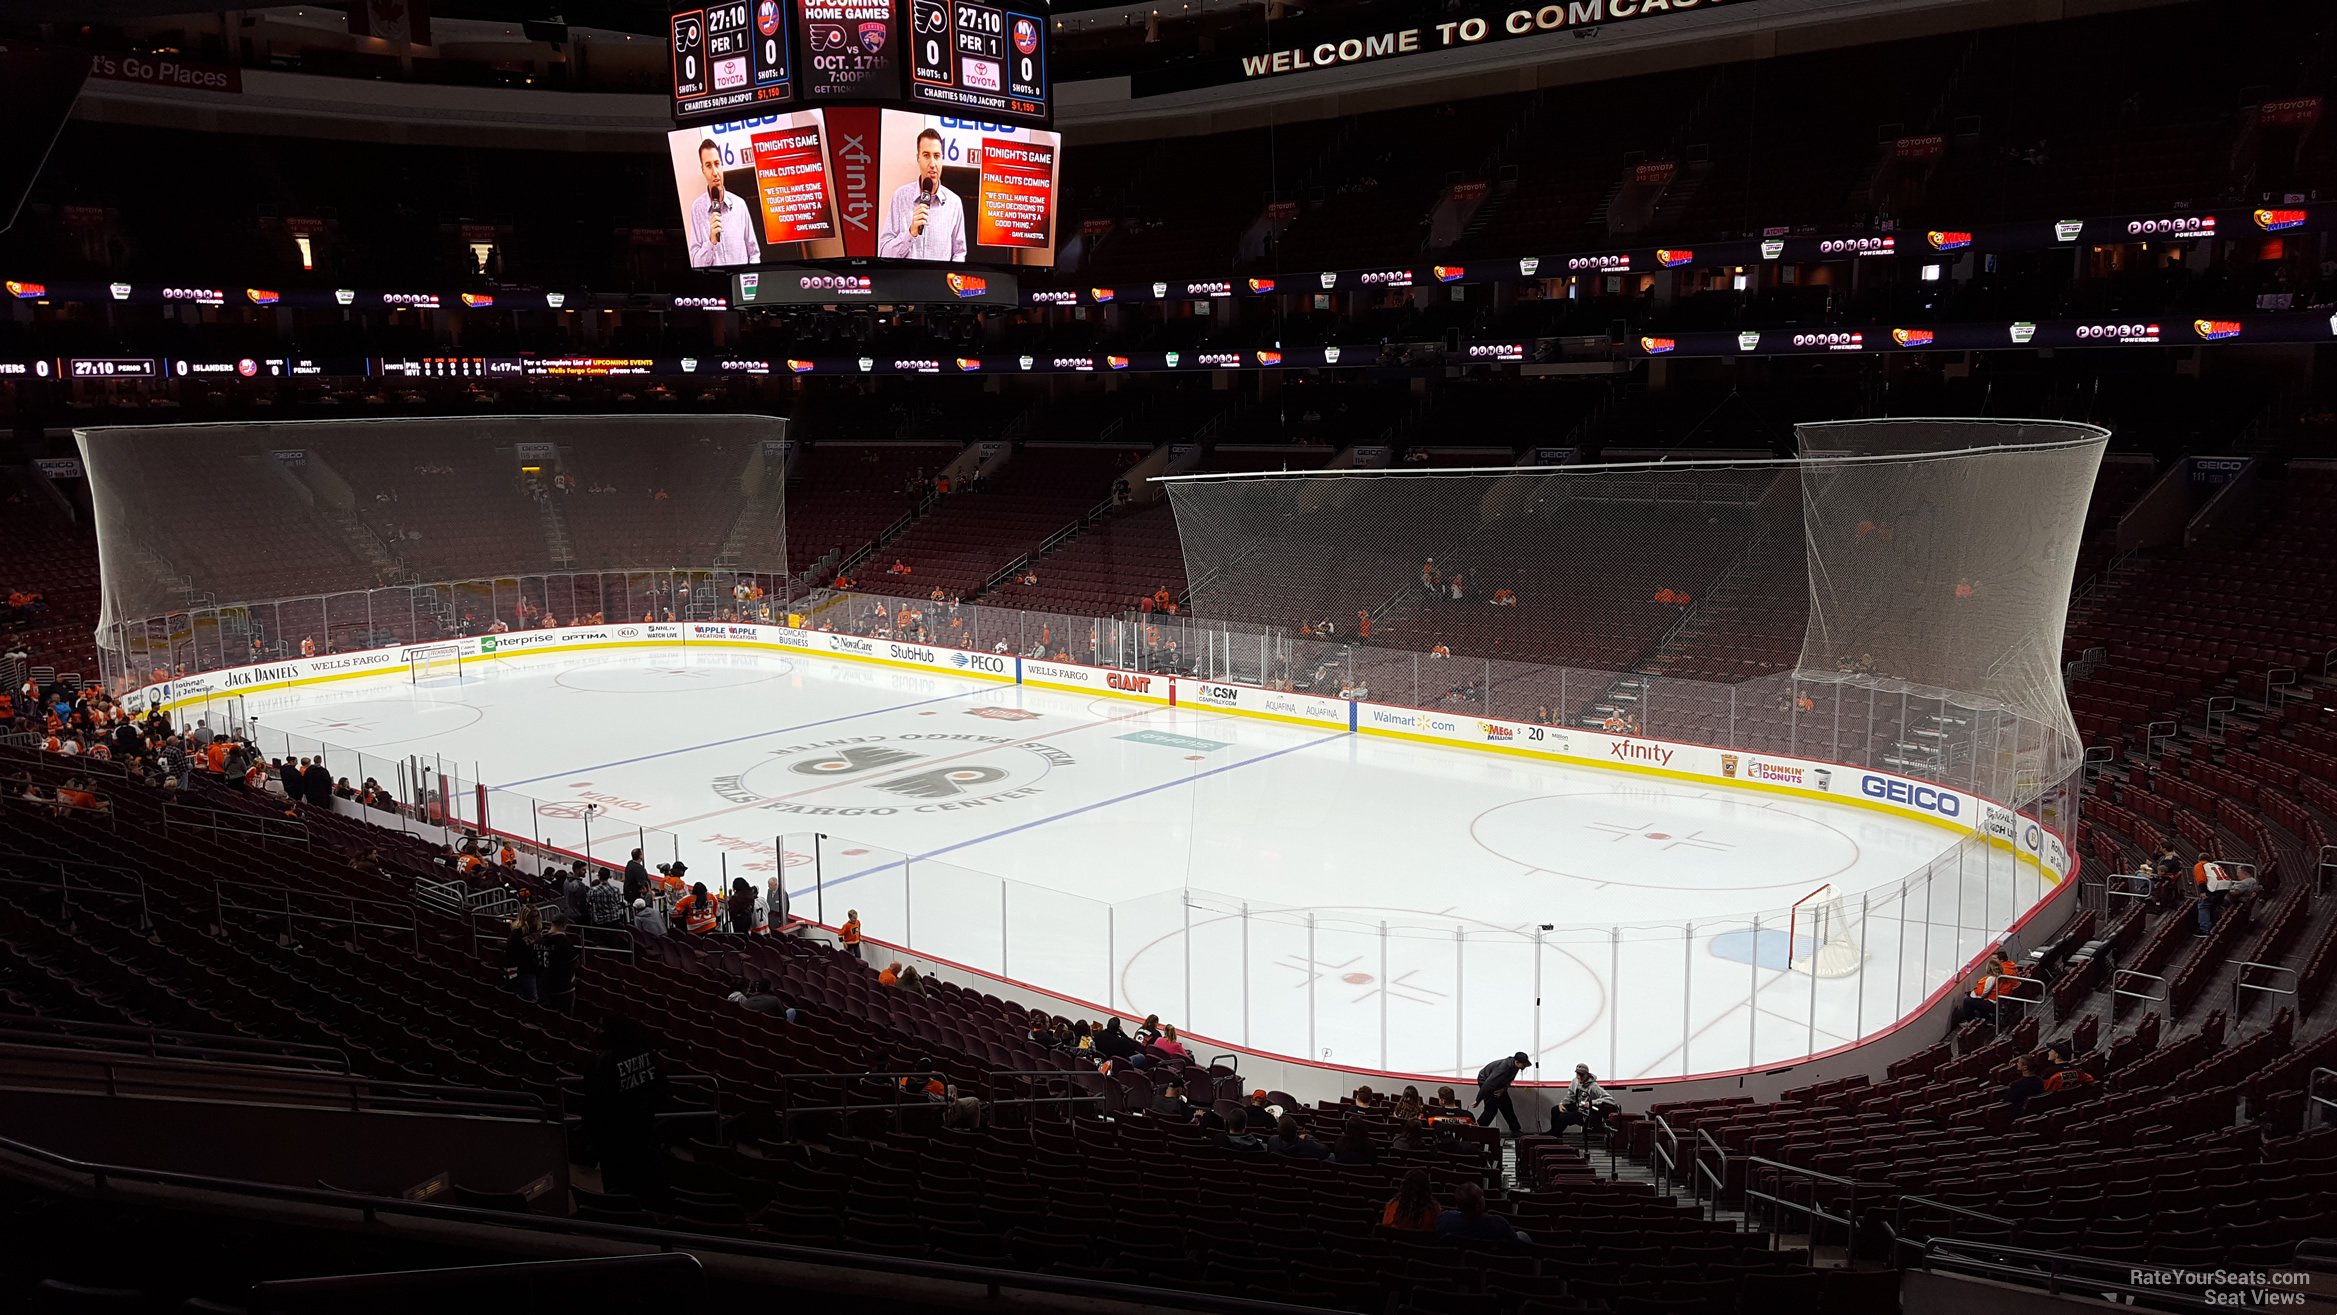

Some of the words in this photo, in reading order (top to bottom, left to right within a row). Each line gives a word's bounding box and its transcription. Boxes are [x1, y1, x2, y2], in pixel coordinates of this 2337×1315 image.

[710, 6, 745, 32] 27:10
[805, 8, 842, 20] HOME
[845, 8, 890, 20] GAMES
[958, 7, 1000, 33] 27:10
[711, 37, 730, 53] PER
[736, 32, 742, 48] 1
[960, 34, 982, 52] PER
[990, 40, 996, 54] 1
[1242, 28, 1419, 77] WELCOME
[1435, 17, 1488, 46] TO
[1506, 0, 1722, 34] COMCA
[765, 40, 776, 64] 0
[926, 40, 940, 65] 0
[686, 56, 696, 80] 0
[814, 56, 849, 70] OCT.
[854, 56, 888, 70] 17th
[1022, 58, 1032, 82] 0
[123, 58, 153, 80] Go
[158, 62, 227, 87] Places
[718, 74, 744, 86] TOYOTA
[758, 68, 778, 80] SHOTS:
[917, 68, 941, 79] SHOTS:
[679, 83, 698, 94] SHOTS:
[966, 75, 996, 88] TOYOTA
[814, 86, 830, 94] GET
[1012, 84, 1034, 95] SHOTS:
[684, 97, 712, 111] CHARITIES
[728, 92, 752, 106] JACKPOT
[758, 87, 780, 100] $1,150
[924, 88, 958, 101] CHARITIES
[978, 96, 1006, 108] JACKPOT
[1012, 100, 1034, 112] $1,150
[754, 138, 794, 153] TONIGHT'S
[796, 134, 818, 147] GAME
[1910, 136, 1942, 146] TOYOTA
[984, 146, 1028, 161] TONIGHT'S
[1028, 152, 1052, 164] GAME
[758, 168, 778, 178] FINAL
[778, 166, 795, 176] CUTS
[796, 163, 822, 174] COMING
[1647, 164, 1674, 172] TOYOTA
[839, 134, 873, 231] xfinity
[984, 173, 1004, 183] FINAL
[1004, 176, 1022, 184] CUTS
[1024, 178, 1050, 188] COMING
[998, 192, 1014, 201] STILL
[1014, 194, 1028, 202] HAVE
[1030, 196, 1045, 204] SOME
[2271, 210, 2306, 224] MEGA
[2128, 218, 2200, 234] POWER
[1942, 232, 1972, 243] MEGA
[1820, 238, 1882, 253] POWER
[1568, 256, 1620, 270] POWER
[800, 276, 858, 289] POWER
[2076, 324, 2145, 338] POWER
[1793, 333, 1850, 346] POWER
[1470, 344, 1514, 357] POWER
[0, 364, 26, 374] YERS
[36, 360, 48, 376] 0
[75, 362, 114, 374] 27:10
[144, 362, 150, 374] 1
[176, 360, 188, 376] 0
[193, 364, 234, 372] ISLANDERS
[272, 366, 280, 376] 0
[2196, 460, 2242, 470] GEICO
[2192, 472, 2204, 481] 111
[562, 632, 608, 641] OPTIMA
[700, 626, 726, 634] APPLE
[731, 628, 756, 636] APPLE
[778, 628, 808, 638] COMCAST
[483, 634, 554, 650] enterprise
[779, 636, 808, 648] BUSINESS
[839, 637, 872, 651] NovaCare
[890, 644, 934, 663] StubHub
[311, 658, 352, 672] WELLS
[352, 653, 390, 666] FARGO
[971, 655, 1004, 673] PECO
[224, 670, 252, 688] JACK
[254, 664, 299, 684] DANIEL'S
[1028, 666, 1057, 677] WELLS
[1058, 668, 1088, 682] FARGO
[1106, 672, 1151, 694] GIANT
[1212, 686, 1238, 700] CSN
[1266, 700, 1296, 714] AQUAFINA
[1306, 706, 1338, 720] AQUAFINA
[1374, 710, 1416, 728] Walmart
[898, 733, 1015, 744] FARGO
[1489, 724, 1513, 736] MEGA
[1528, 727, 1544, 742] 20
[768, 734, 886, 756] CENTER
[1611, 740, 1674, 766] xfinity
[1763, 763, 1805, 776] DUNKIN'
[1762, 772, 1802, 784] DONUTS
[711, 774, 760, 804] WELLS
[759, 802, 900, 816] FARGO
[914, 786, 1044, 814] CENTER
[1861, 774, 1960, 818] GEICO
[617, 1052, 650, 1078] EVENT
[620, 1066, 656, 1090] STAFF
